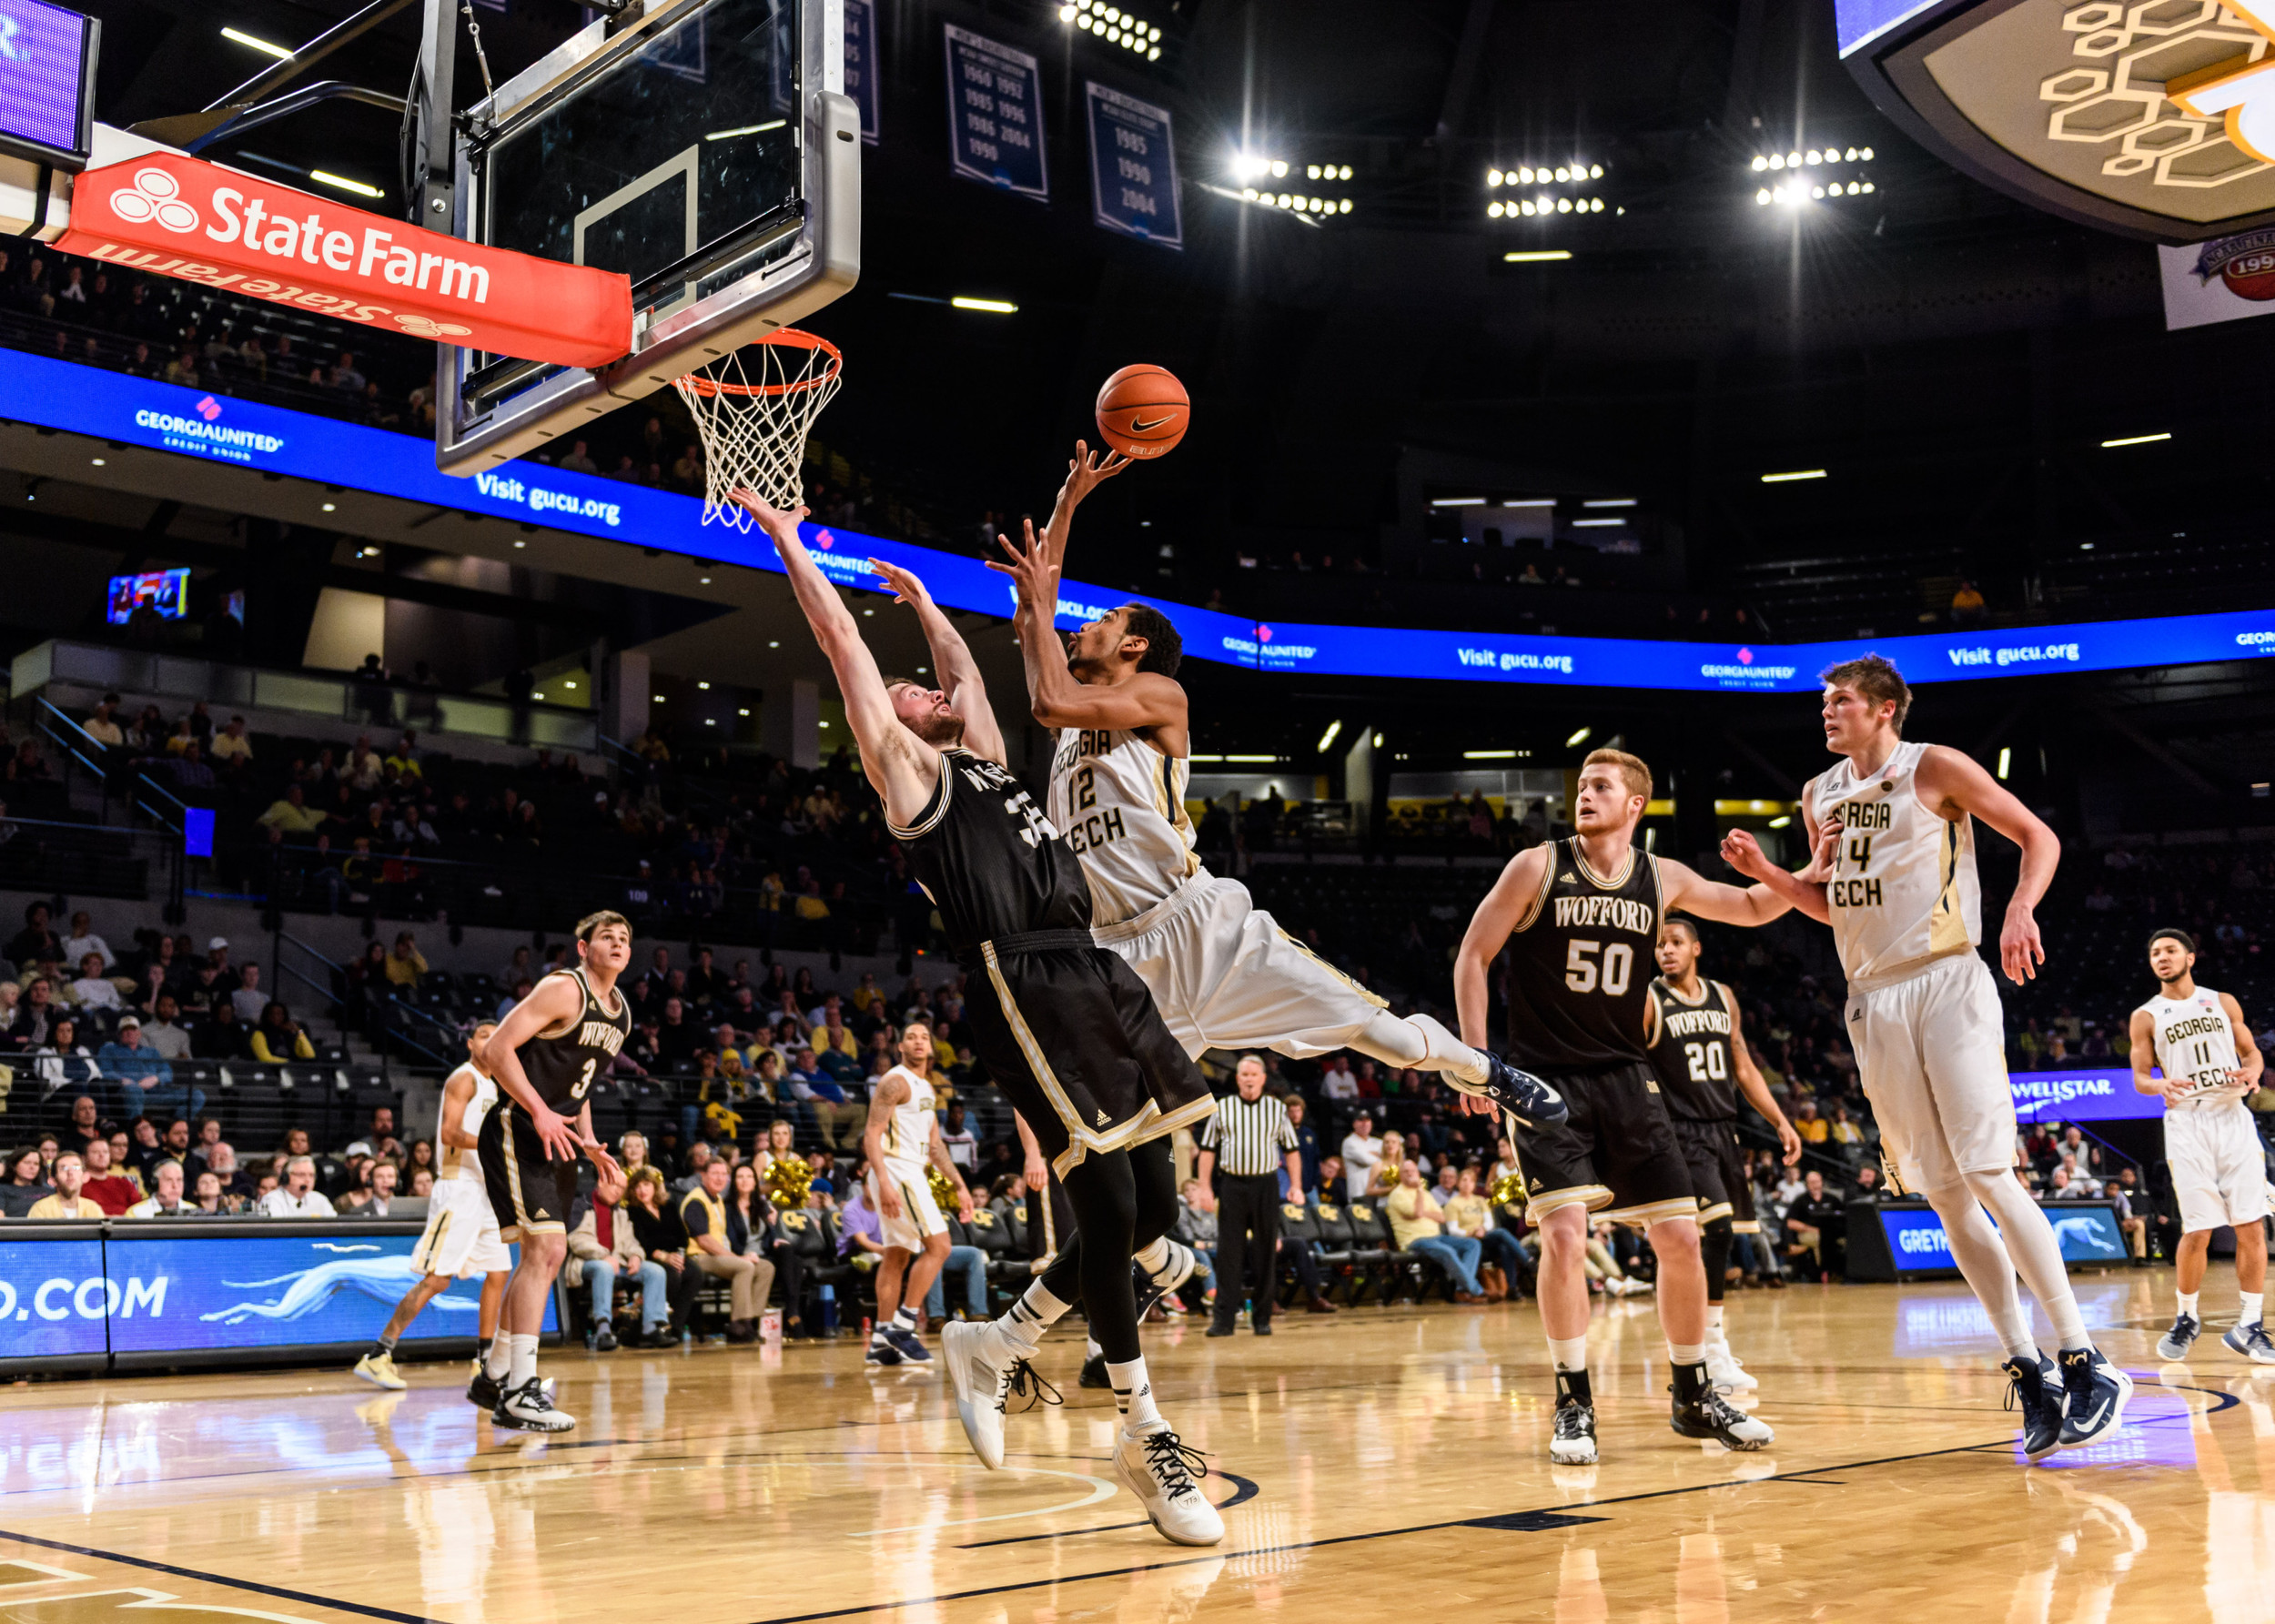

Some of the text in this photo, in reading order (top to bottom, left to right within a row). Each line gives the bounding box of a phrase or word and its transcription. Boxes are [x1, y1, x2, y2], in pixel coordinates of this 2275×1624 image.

[476, 471, 621, 527] Visit gucu.org
[1457, 648, 1572, 673] Visit gucu.org
[1947, 642, 2080, 666] Visit gucu.org
[1068, 765, 1097, 818] 12
[1061, 807, 1126, 854] ECH
[1833, 878, 1883, 908] ECH
[1554, 895, 1653, 935] WOFFORD
[1564, 938, 1633, 997] 50
[1664, 1009, 1731, 1039] WOFFORD
[2165, 1016, 2225, 1044] GEORGIA
[1684, 1040, 1727, 1082] 20
[2194, 1041, 2210, 1065] 11
[571, 1057, 597, 1100] 3
